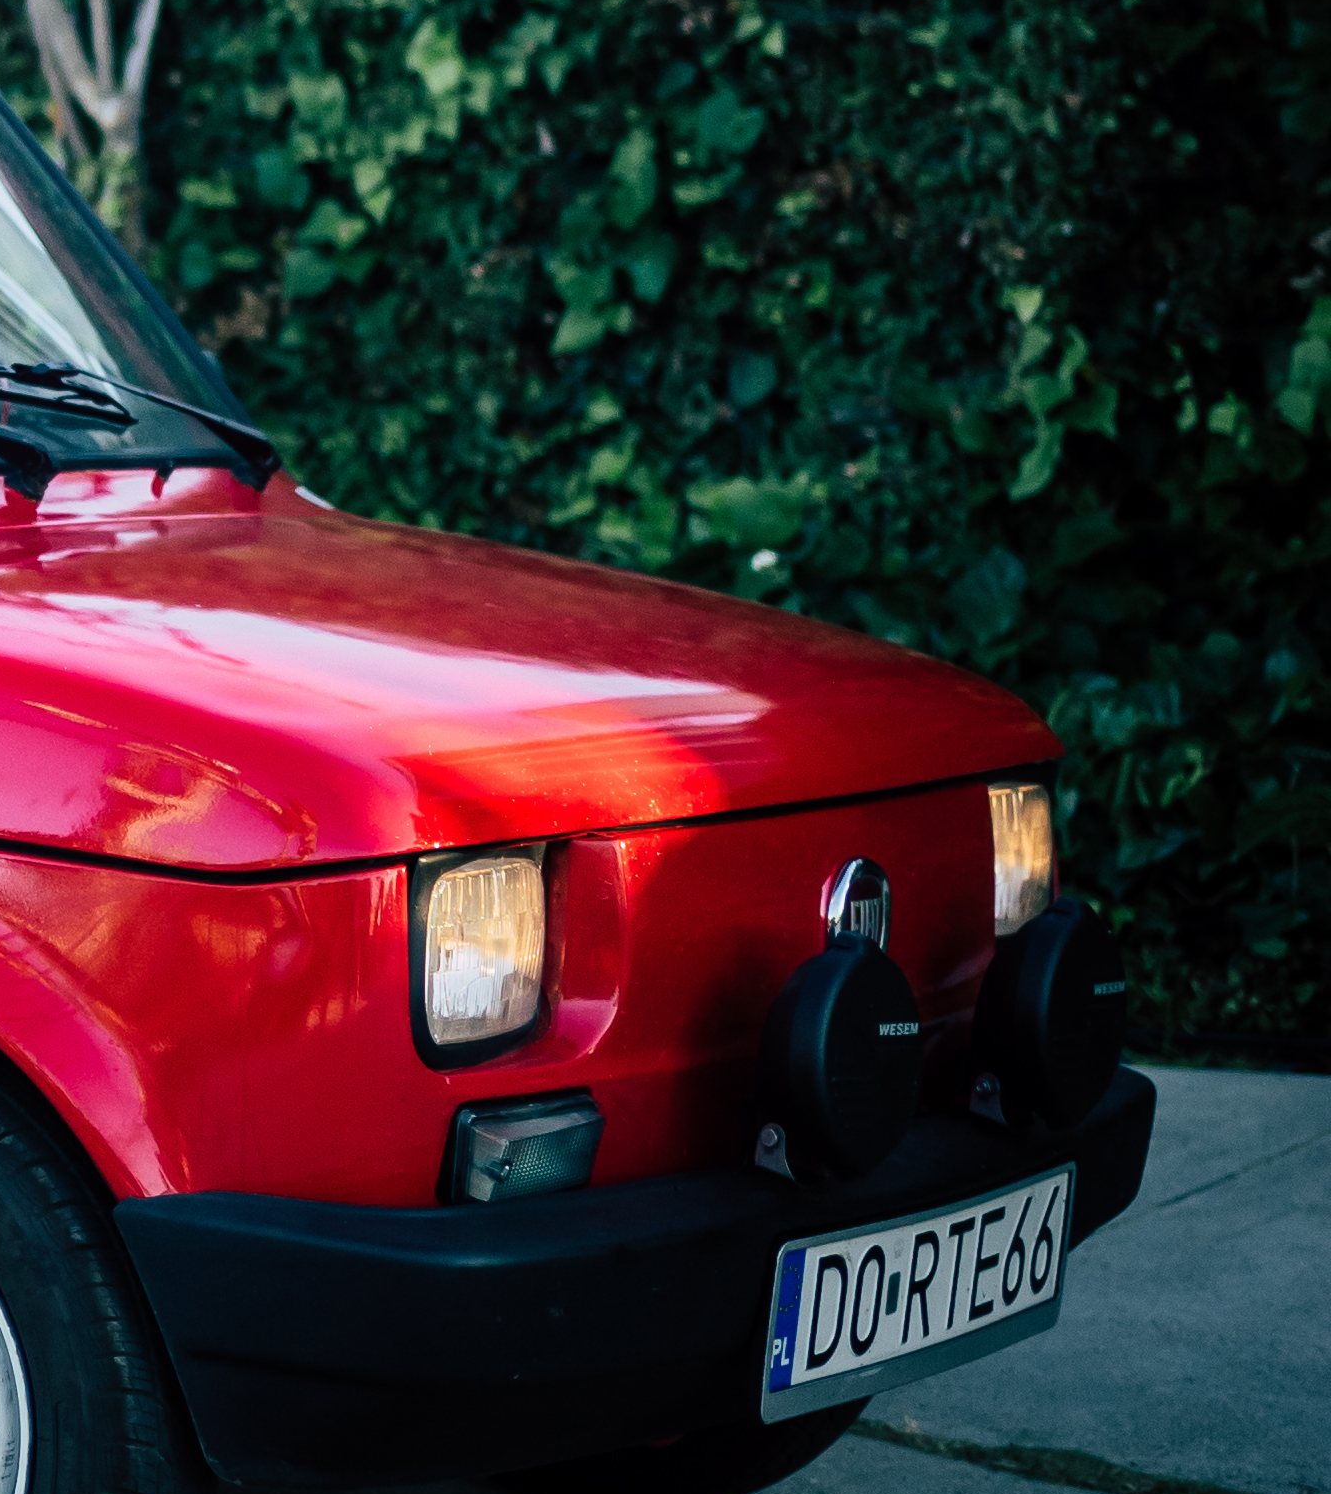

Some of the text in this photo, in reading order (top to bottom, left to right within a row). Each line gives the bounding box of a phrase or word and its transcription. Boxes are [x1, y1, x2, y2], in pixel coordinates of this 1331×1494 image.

[879, 1022, 919, 1036] WESEM
[900, 1185, 1061, 1345] RTE66
[770, 1336, 790, 1369] PL
